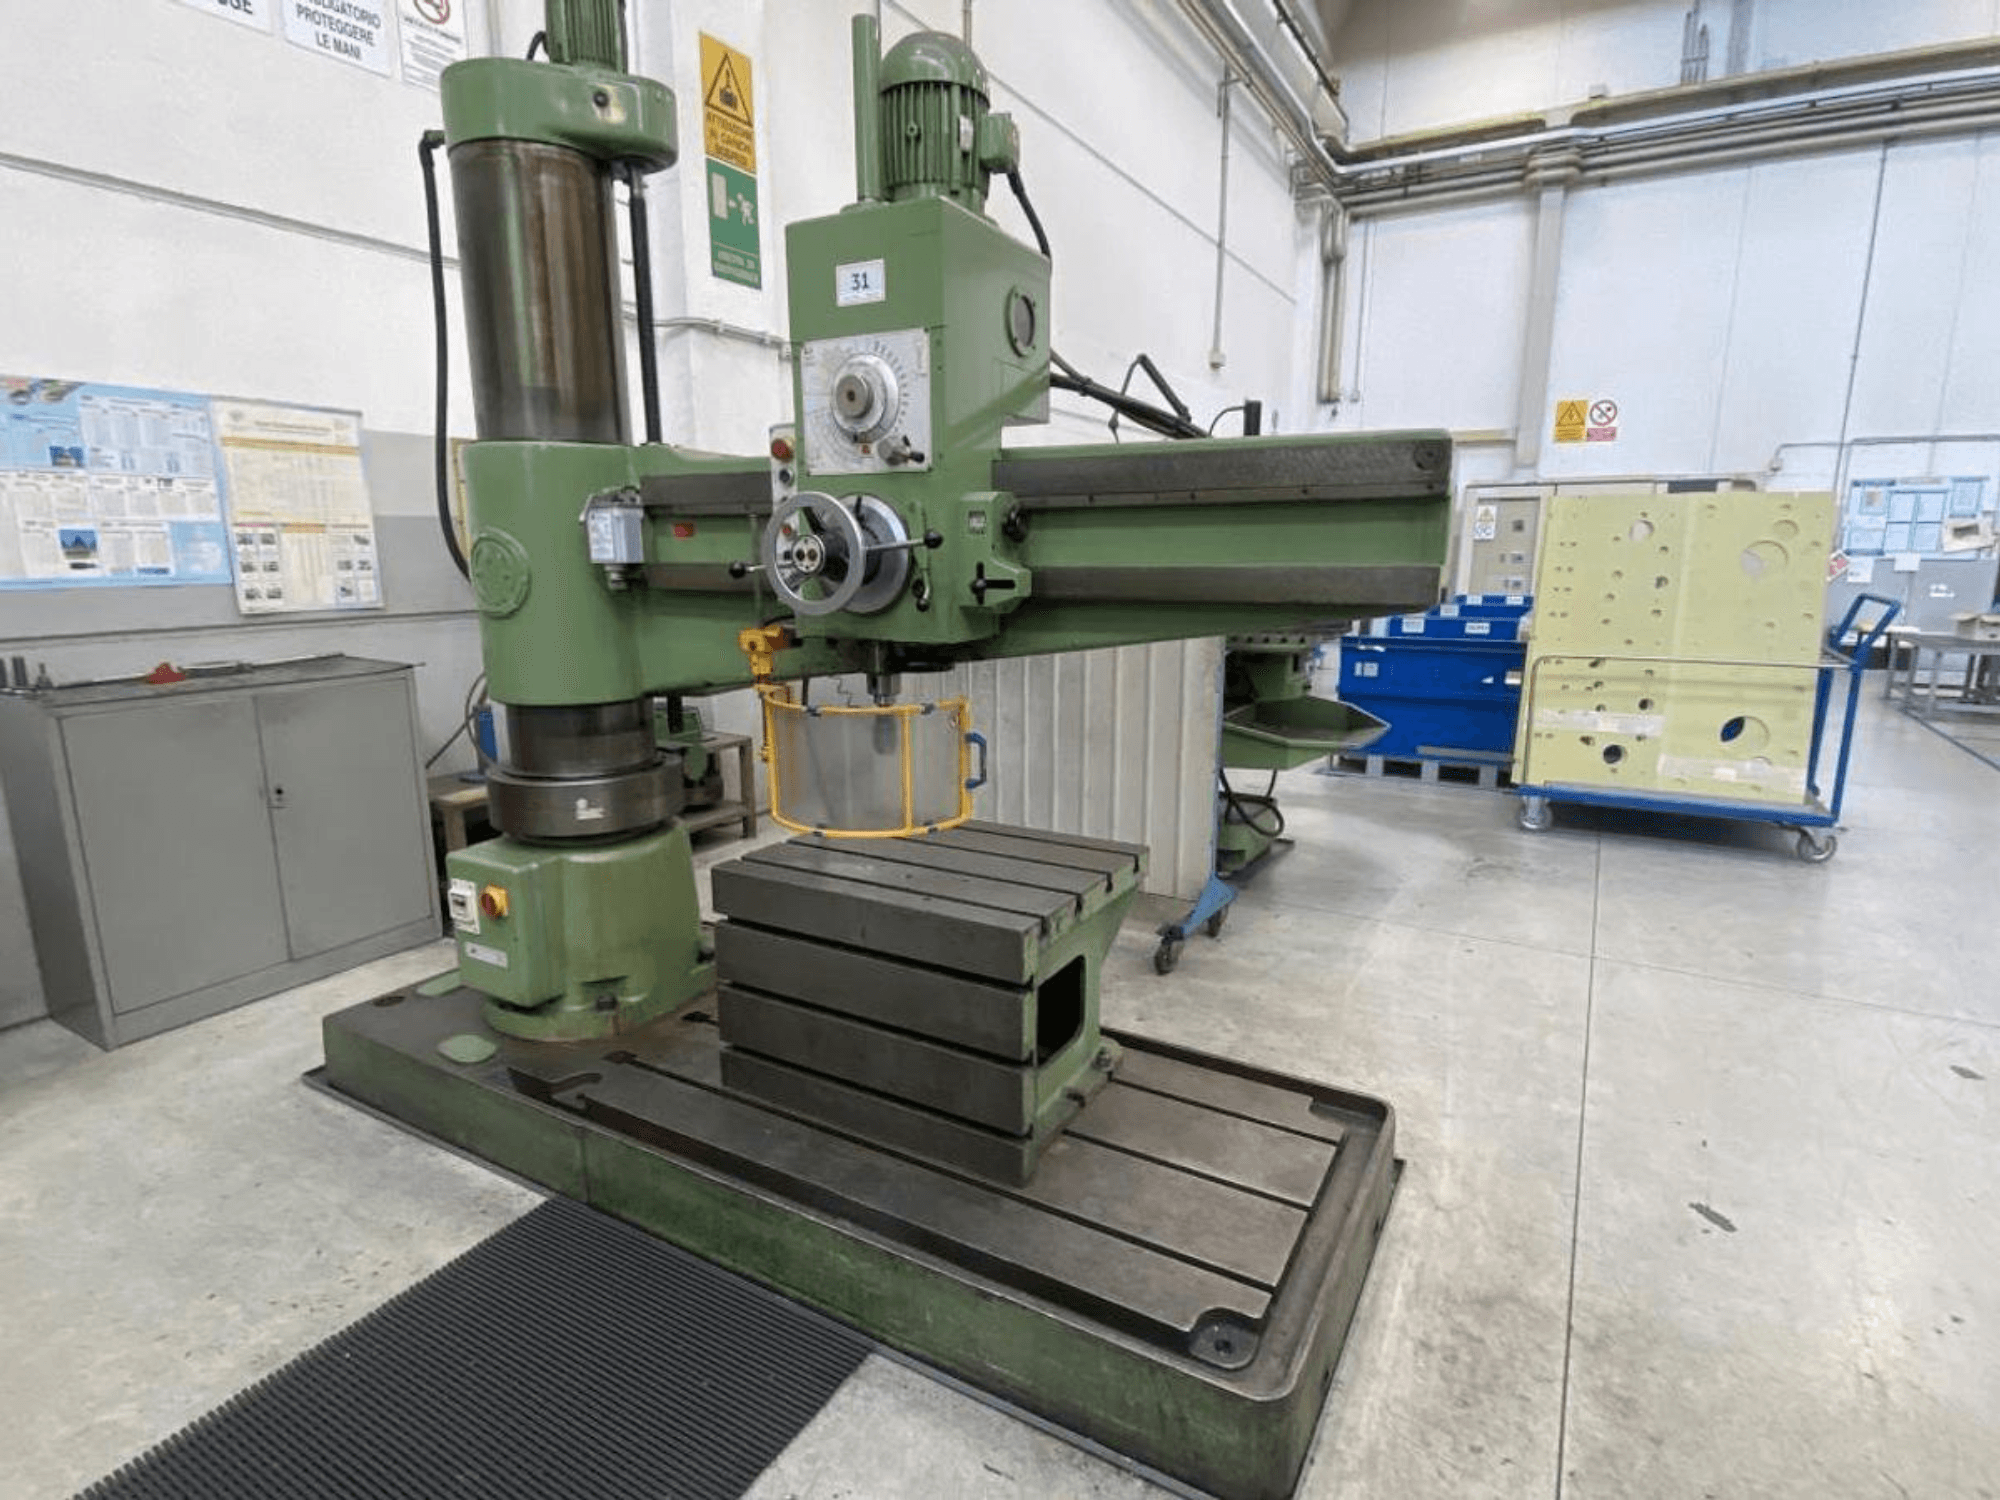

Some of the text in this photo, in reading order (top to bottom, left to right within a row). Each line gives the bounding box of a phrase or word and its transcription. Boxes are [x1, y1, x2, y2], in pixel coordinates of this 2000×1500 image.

[296, 3, 376, 47] PROTEGGERE
[315, 30, 362, 60] LE MANI
[852, 271, 870, 291] 31
